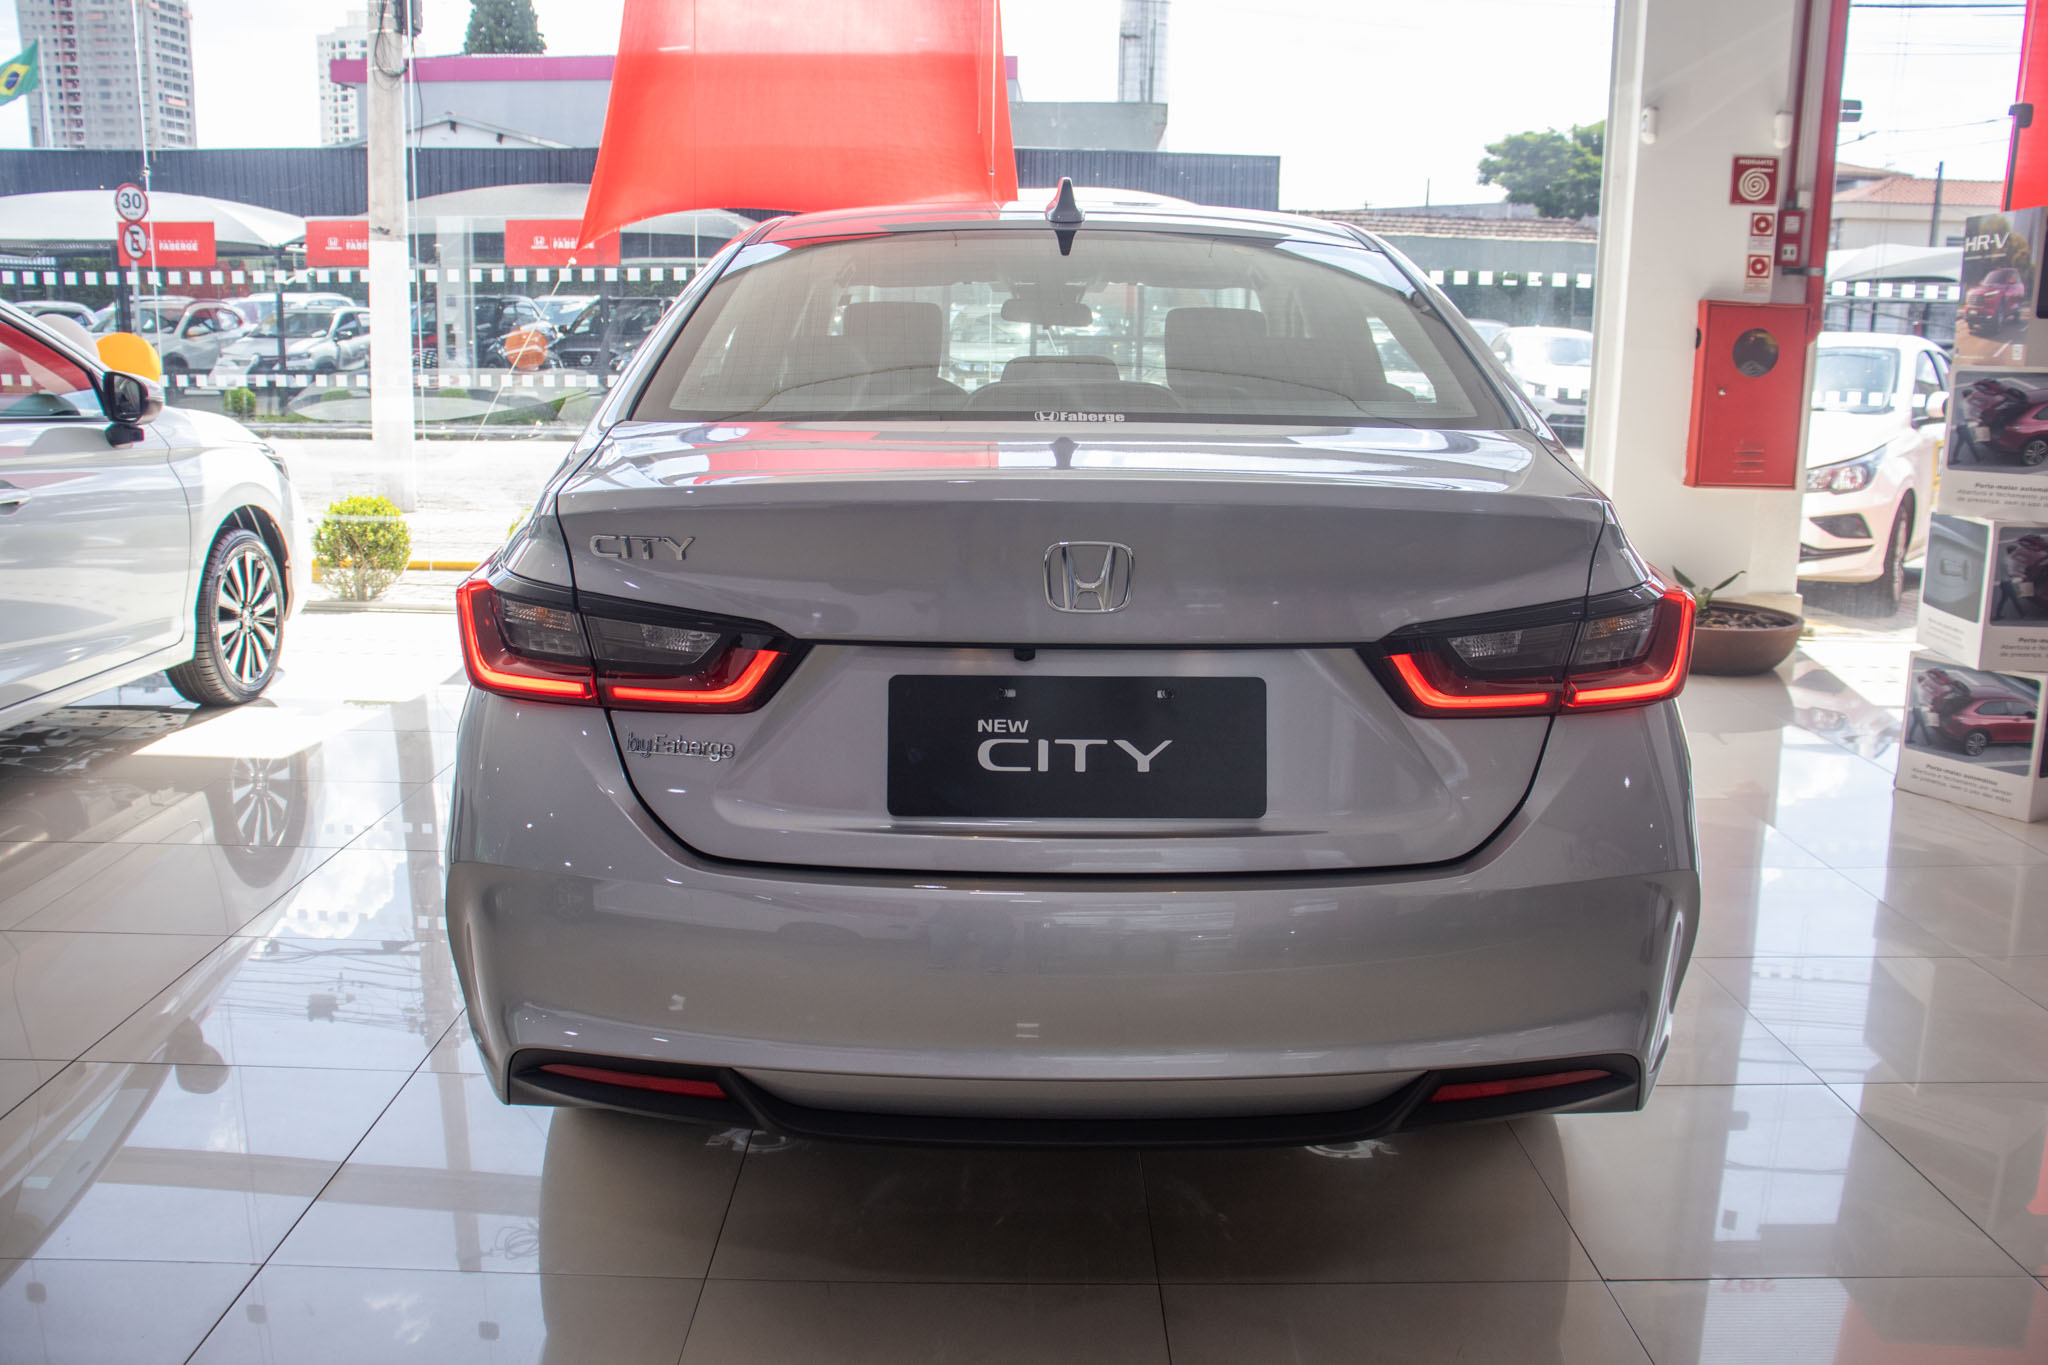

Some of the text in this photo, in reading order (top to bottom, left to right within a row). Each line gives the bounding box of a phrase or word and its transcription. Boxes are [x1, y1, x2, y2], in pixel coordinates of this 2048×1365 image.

[121, 193, 141, 209] 30
[1965, 231, 2010, 252] HR-V
[1060, 412, 1125, 423] Faberge
[590, 535, 695, 560] CITY
[977, 719, 1029, 733] NEW
[977, 738, 1174, 773] CITY
